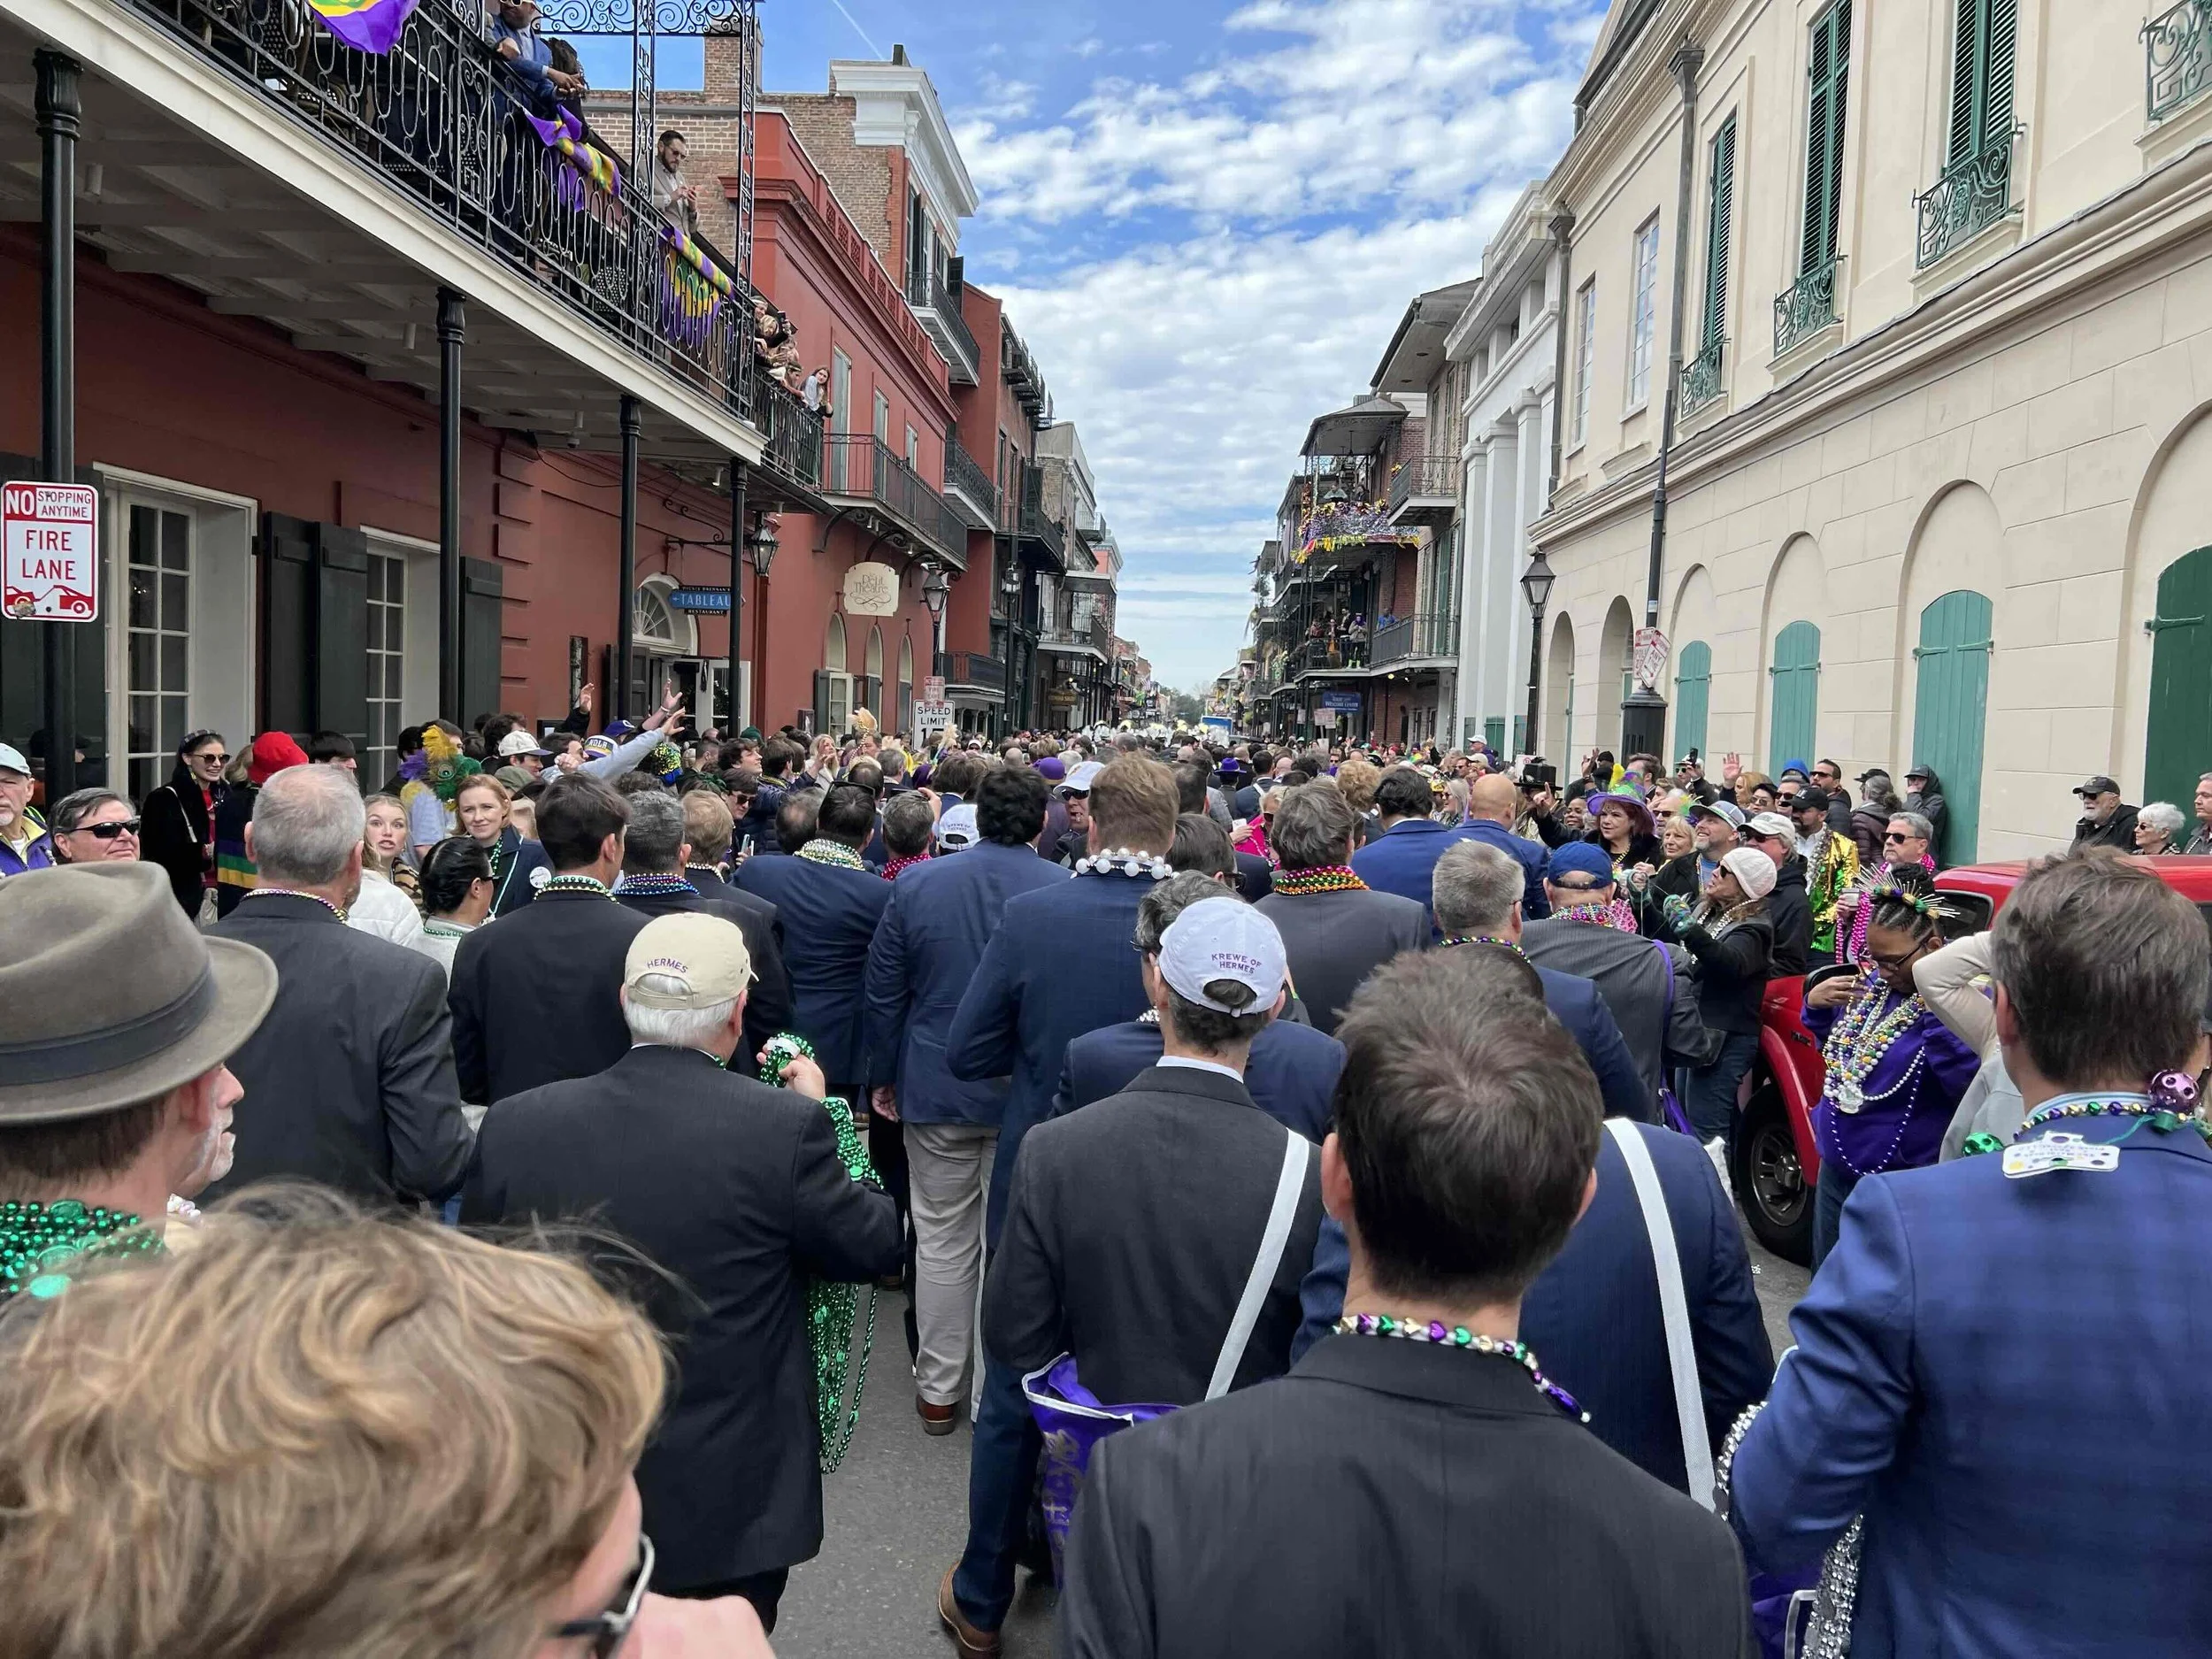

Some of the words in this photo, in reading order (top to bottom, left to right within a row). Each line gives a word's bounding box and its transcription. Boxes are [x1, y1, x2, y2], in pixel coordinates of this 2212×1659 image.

[5, 489, 35, 516] NO
[38, 490, 91, 504] STOPPING
[41, 504, 88, 518] ANYTIME
[26, 529, 73, 551] FIRE
[21, 558, 77, 580] LANE
[680, 593, 730, 607] TABLEAU
[918, 706, 951, 715] SPEED
[920, 717, 946, 726] LIMIT
[647, 958, 688, 973] HERMES
[1211, 953, 1248, 964] KREWE
[1250, 958, 1263, 968] OF
[1219, 961, 1256, 974] HERMES
